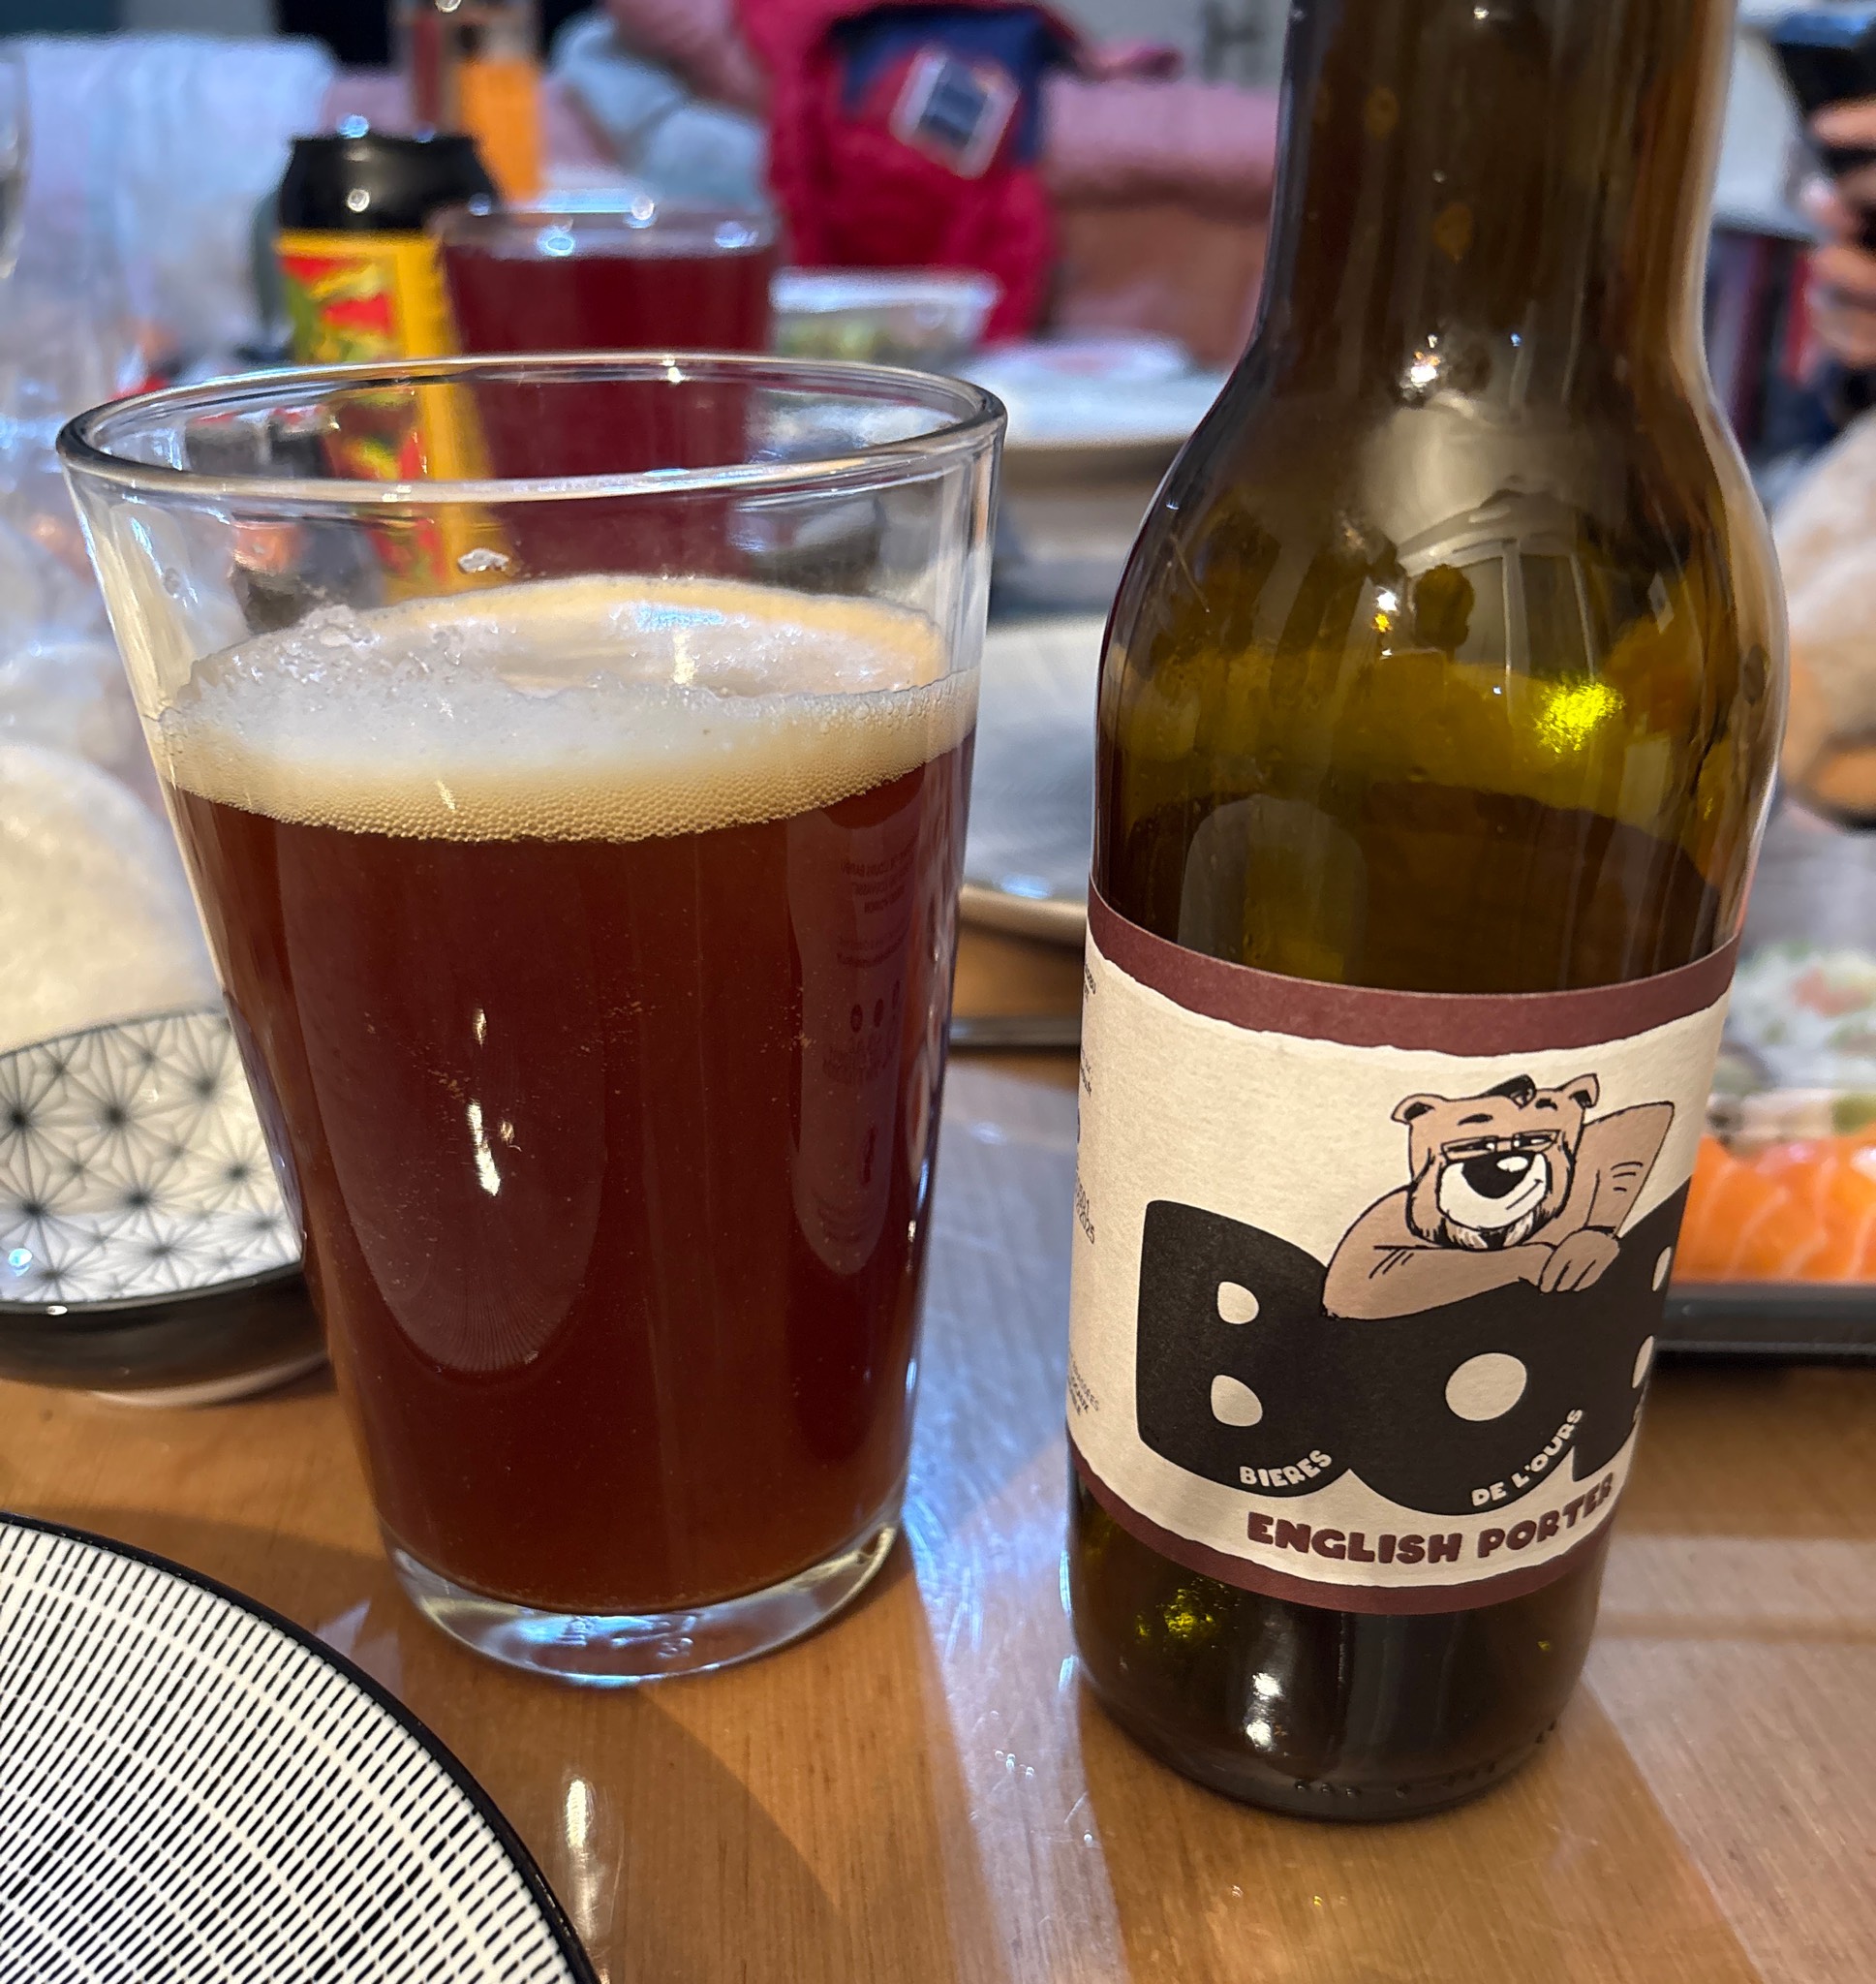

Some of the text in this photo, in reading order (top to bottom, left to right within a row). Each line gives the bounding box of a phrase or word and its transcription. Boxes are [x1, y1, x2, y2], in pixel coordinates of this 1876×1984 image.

[1240, 1409, 1583, 1506] BIERES DE L'OURS
[1247, 1472, 1614, 1564] ENGLISH PORTER
